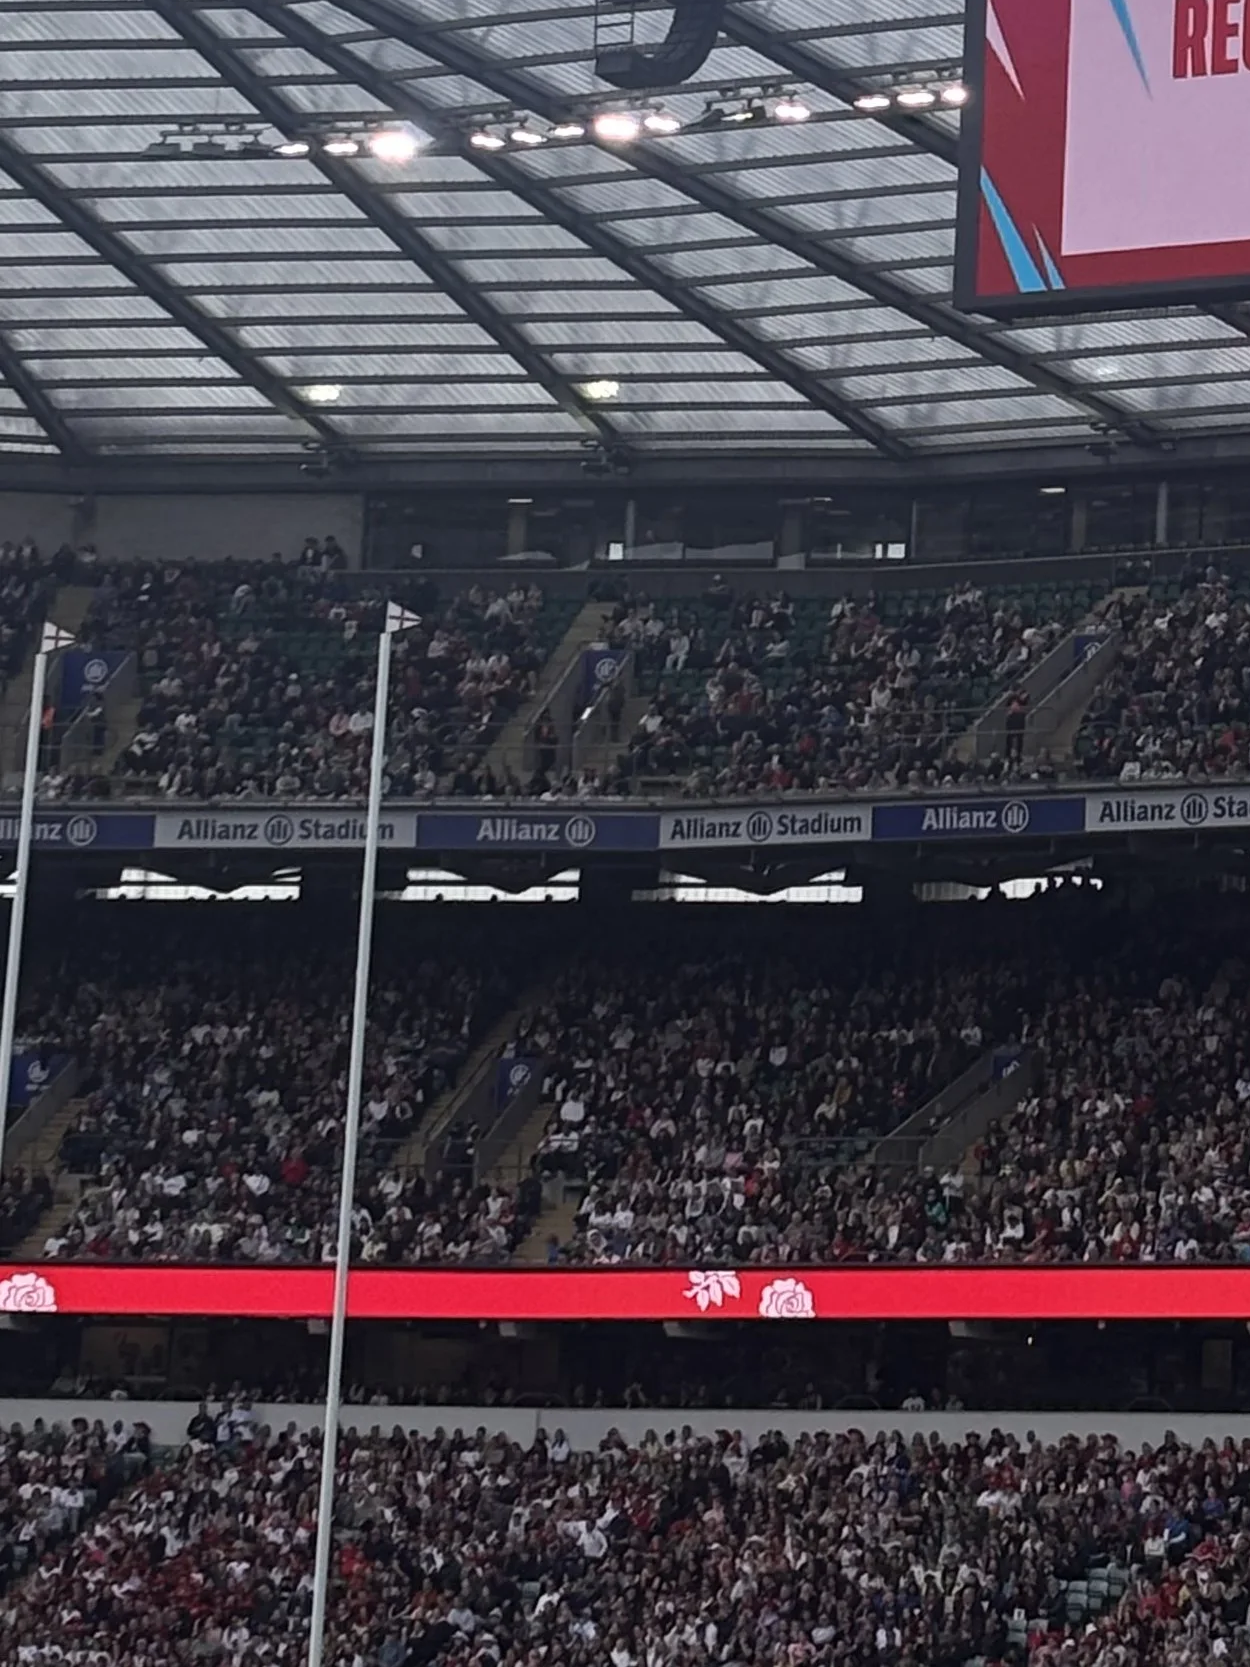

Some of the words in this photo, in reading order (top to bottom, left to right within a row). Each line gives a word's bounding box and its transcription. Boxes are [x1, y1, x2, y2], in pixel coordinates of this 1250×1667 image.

[922, 807, 997, 831] Allianz
[1099, 799, 1177, 823] Allianz
[177, 819, 258, 841] Allianz
[477, 819, 560, 841] Allianz
[670, 817, 743, 841] Allianz
[776, 813, 862, 837] Stadium
